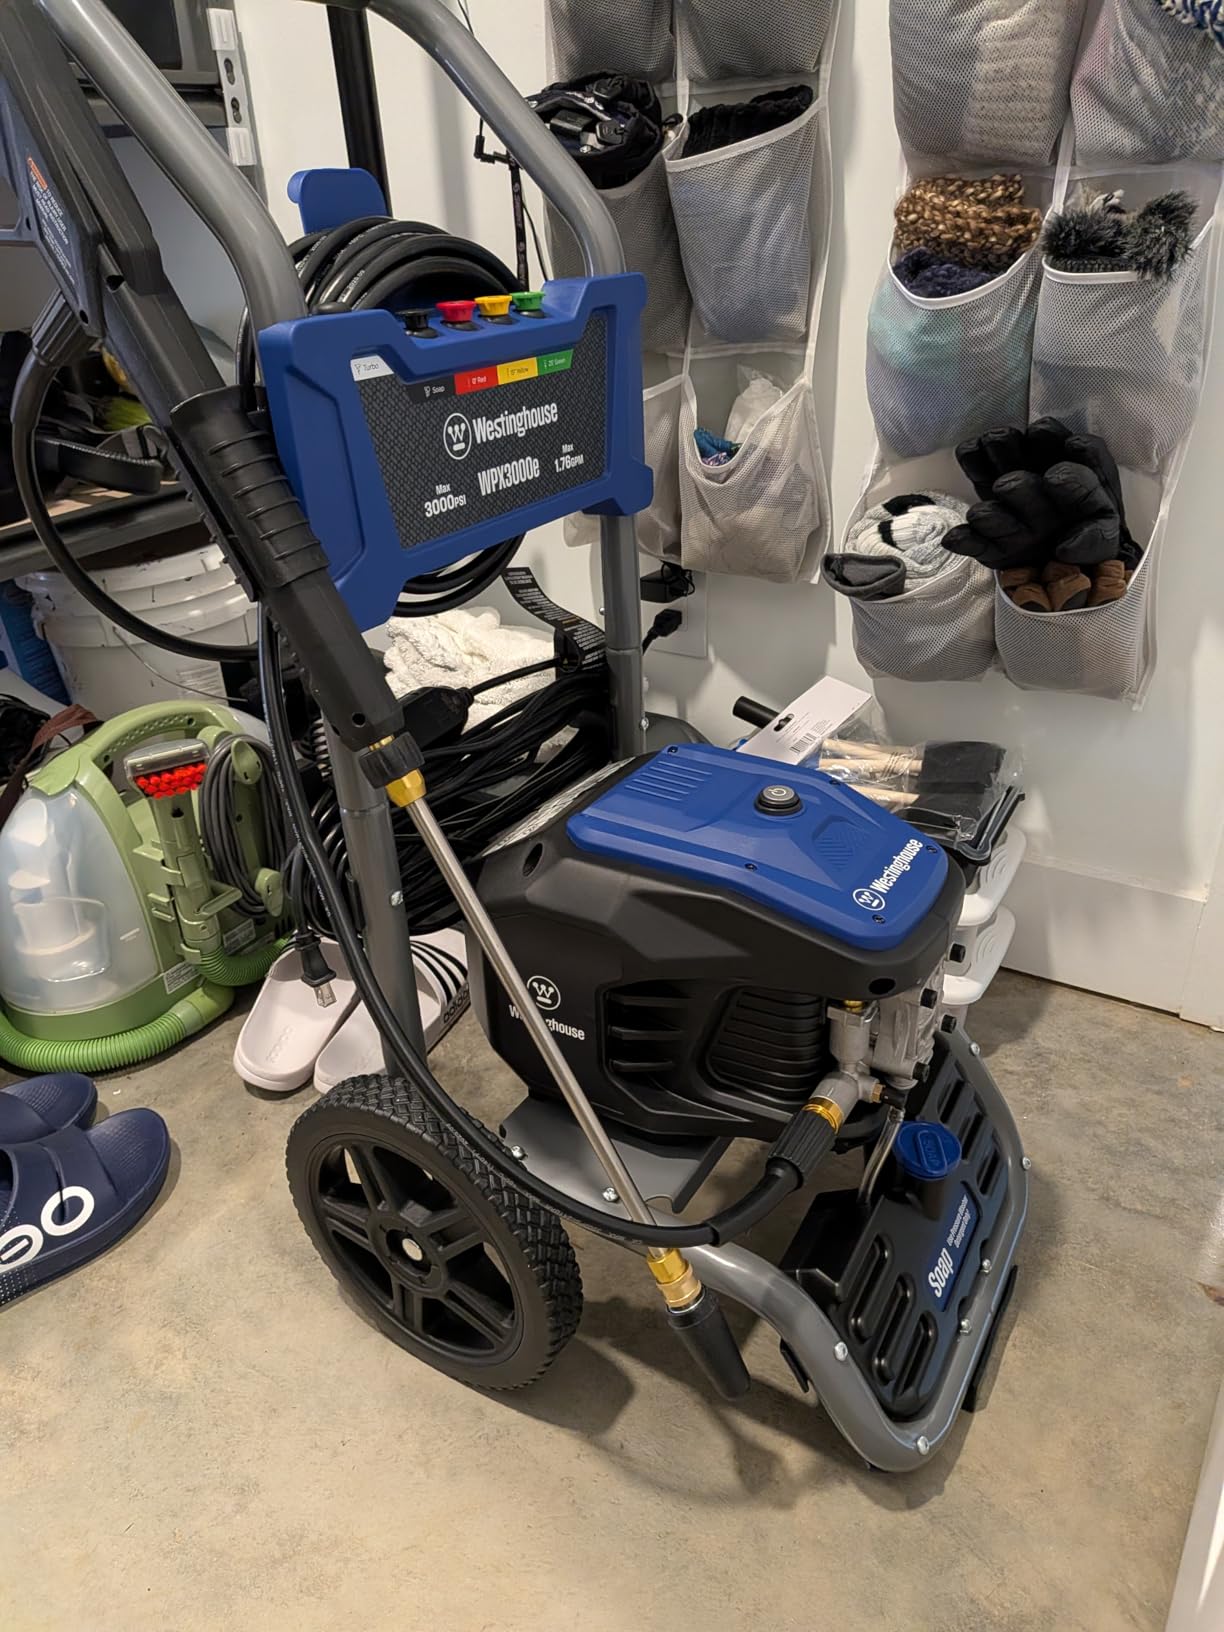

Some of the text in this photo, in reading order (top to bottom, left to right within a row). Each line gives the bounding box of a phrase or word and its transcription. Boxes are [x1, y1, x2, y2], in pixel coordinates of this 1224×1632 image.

[432, 385, 445, 394] Soap
[472, 403, 558, 444] Westinghouse
[562, 444, 574, 454] Max
[435, 483, 451, 495] Max
[477, 456, 540, 496] WPX3000e
[869, 839, 923, 893] Westinghouse
[928, 1247, 954, 1298] Soap
